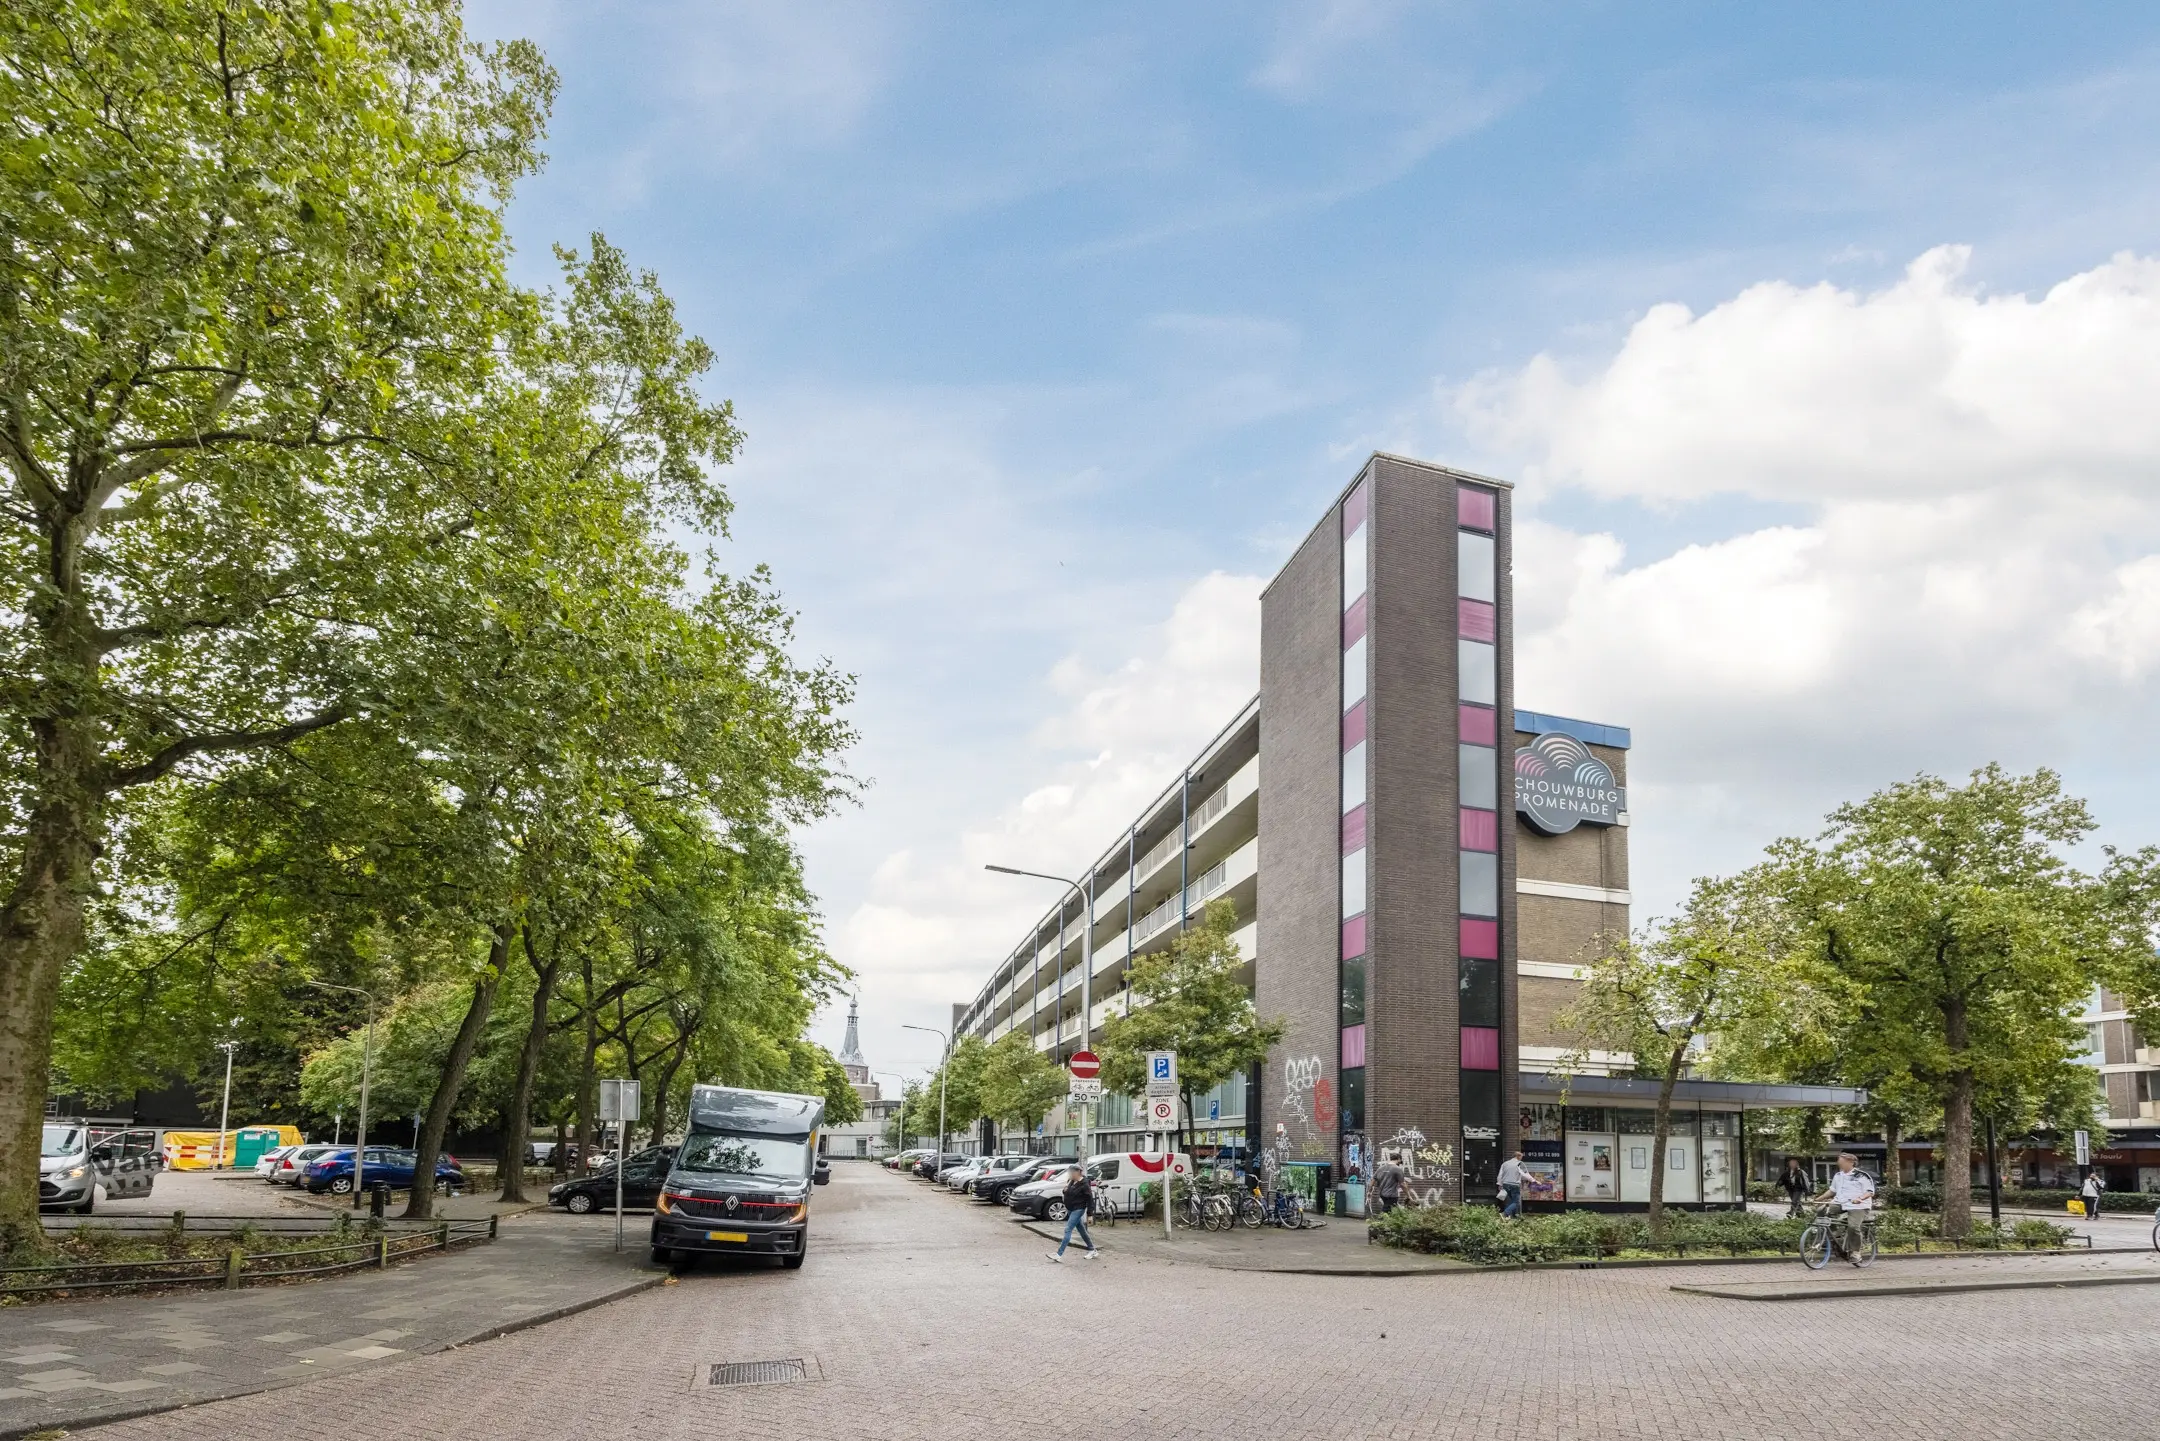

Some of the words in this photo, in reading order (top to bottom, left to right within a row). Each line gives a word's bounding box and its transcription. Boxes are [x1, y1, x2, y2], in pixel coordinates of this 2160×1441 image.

[1515, 777, 1618, 803] CHOUWBURG
[1515, 791, 1609, 816] PROMENADE
[1157, 1059, 1166, 1070] P
[1074, 1093, 1088, 1101] 50
[1211, 1101, 1217, 1112] P
[93, 1151, 164, 1176] van
